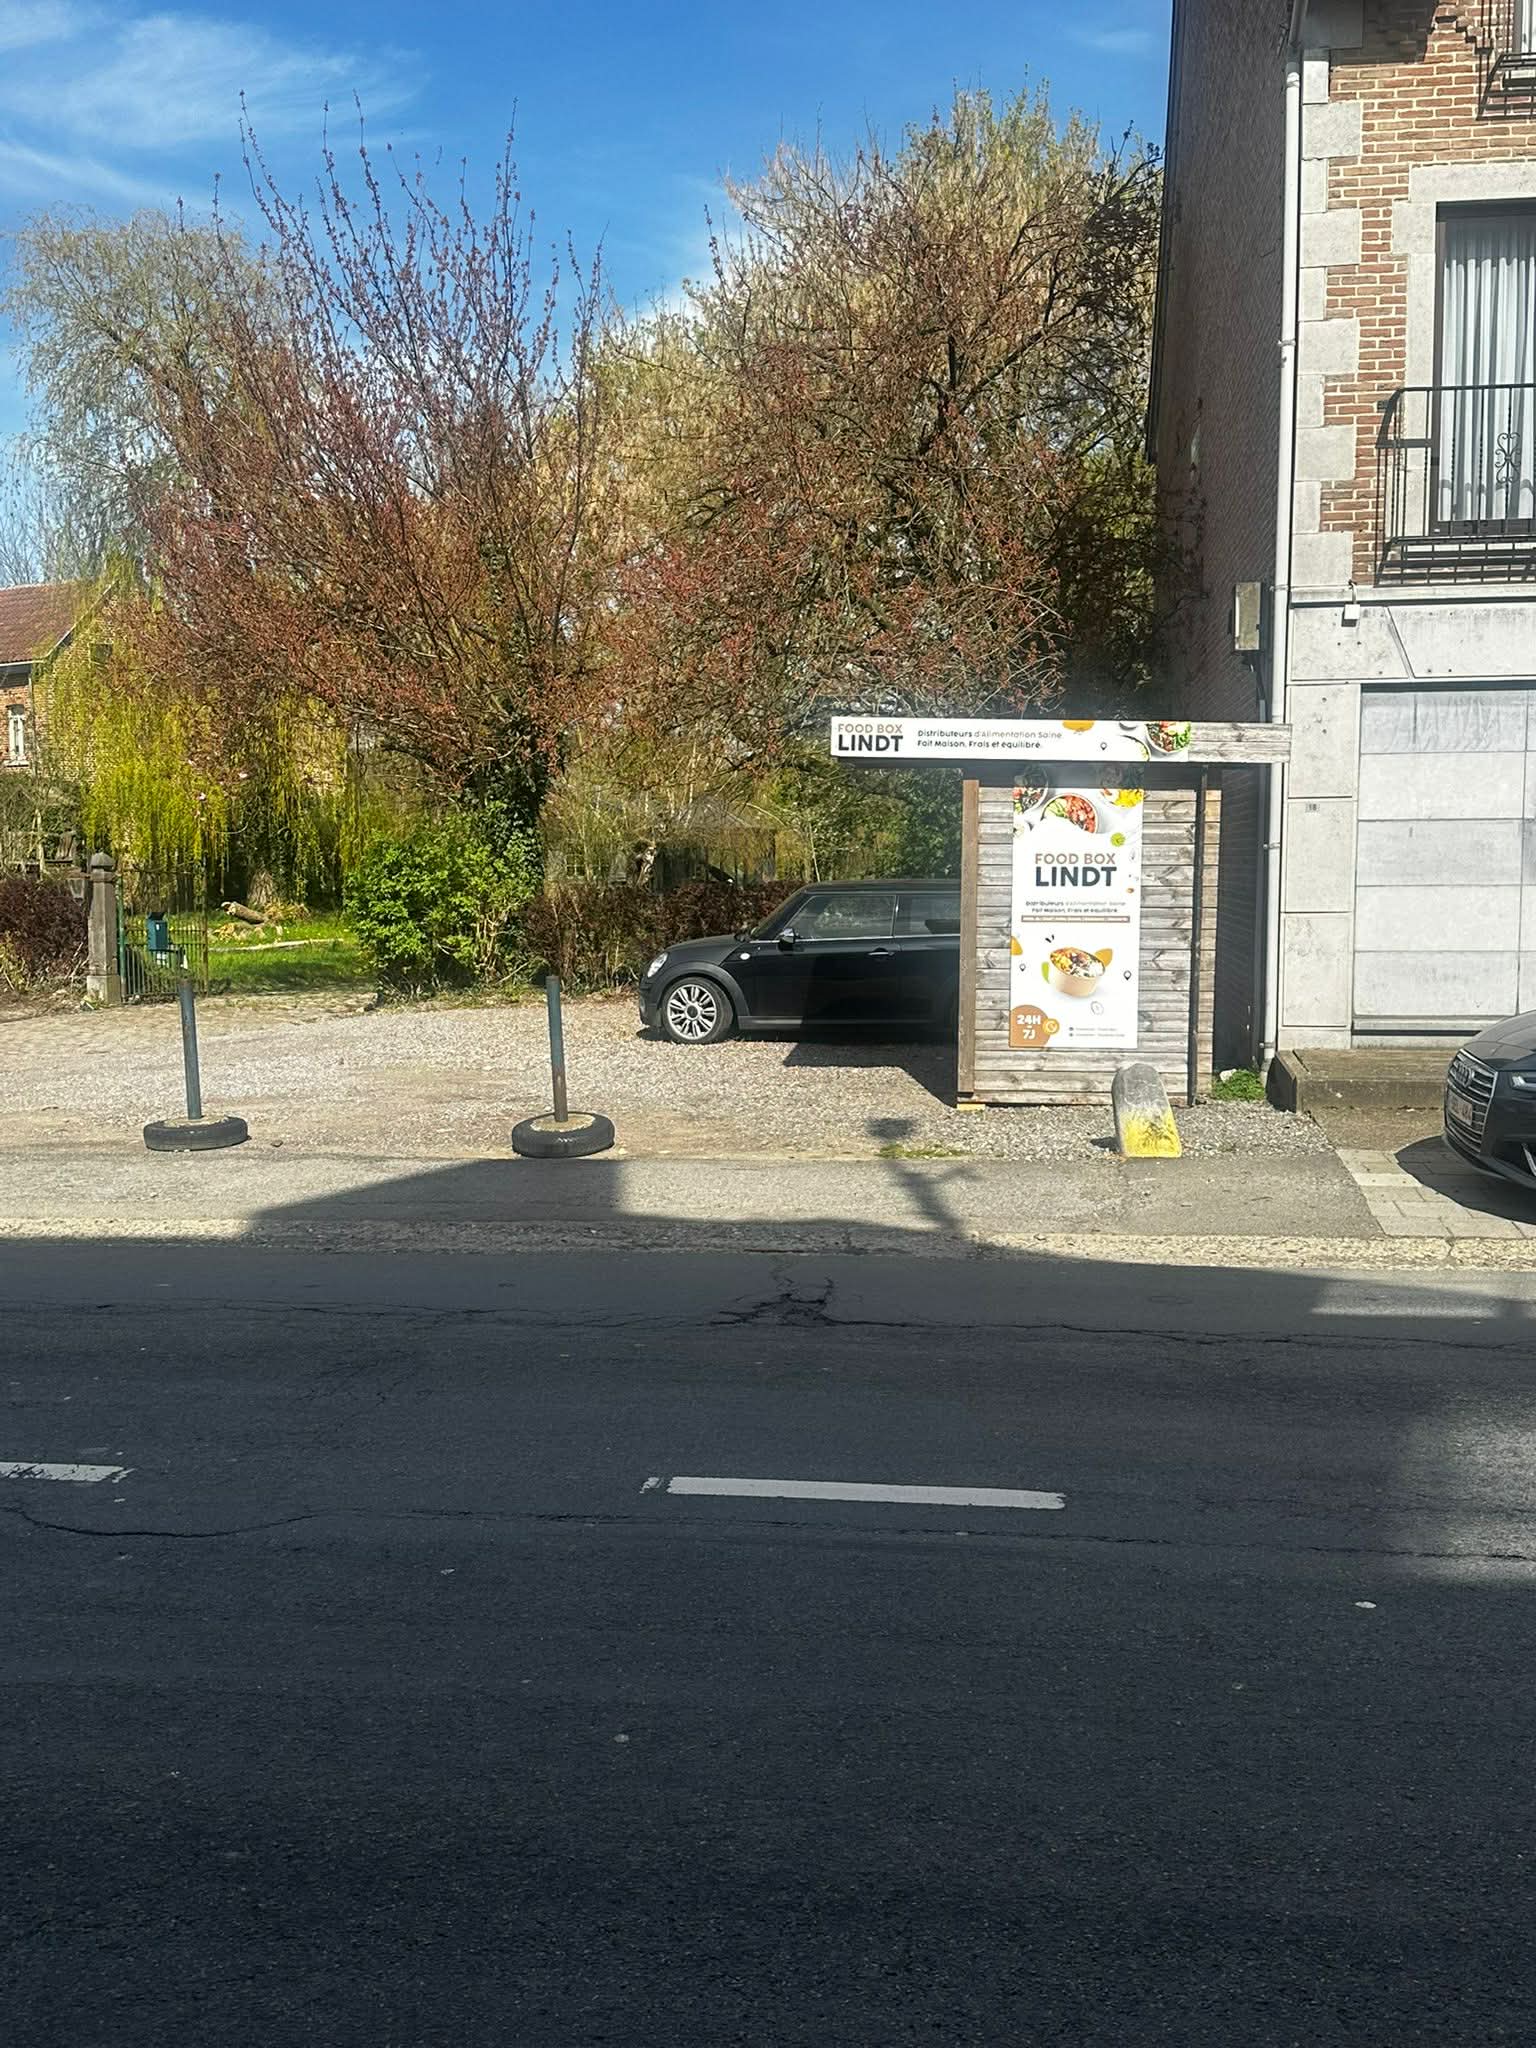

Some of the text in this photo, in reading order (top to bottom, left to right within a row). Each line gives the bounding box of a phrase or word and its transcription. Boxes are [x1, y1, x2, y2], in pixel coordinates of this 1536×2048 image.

[838, 724, 903, 734] FOOD BOX
[917, 730, 972, 738] Distributeurs
[1038, 731, 1062, 739] Saine
[838, 734, 903, 752] LINDT
[969, 740, 990, 748] Frais
[991, 740, 1000, 748] et
[1035, 853, 1116, 865] FOOD BOX
[1035, 866, 1117, 887] LINDT
[1017, 1015, 1041, 1025] 24H
[1022, 1030, 1036, 1040] 7J
